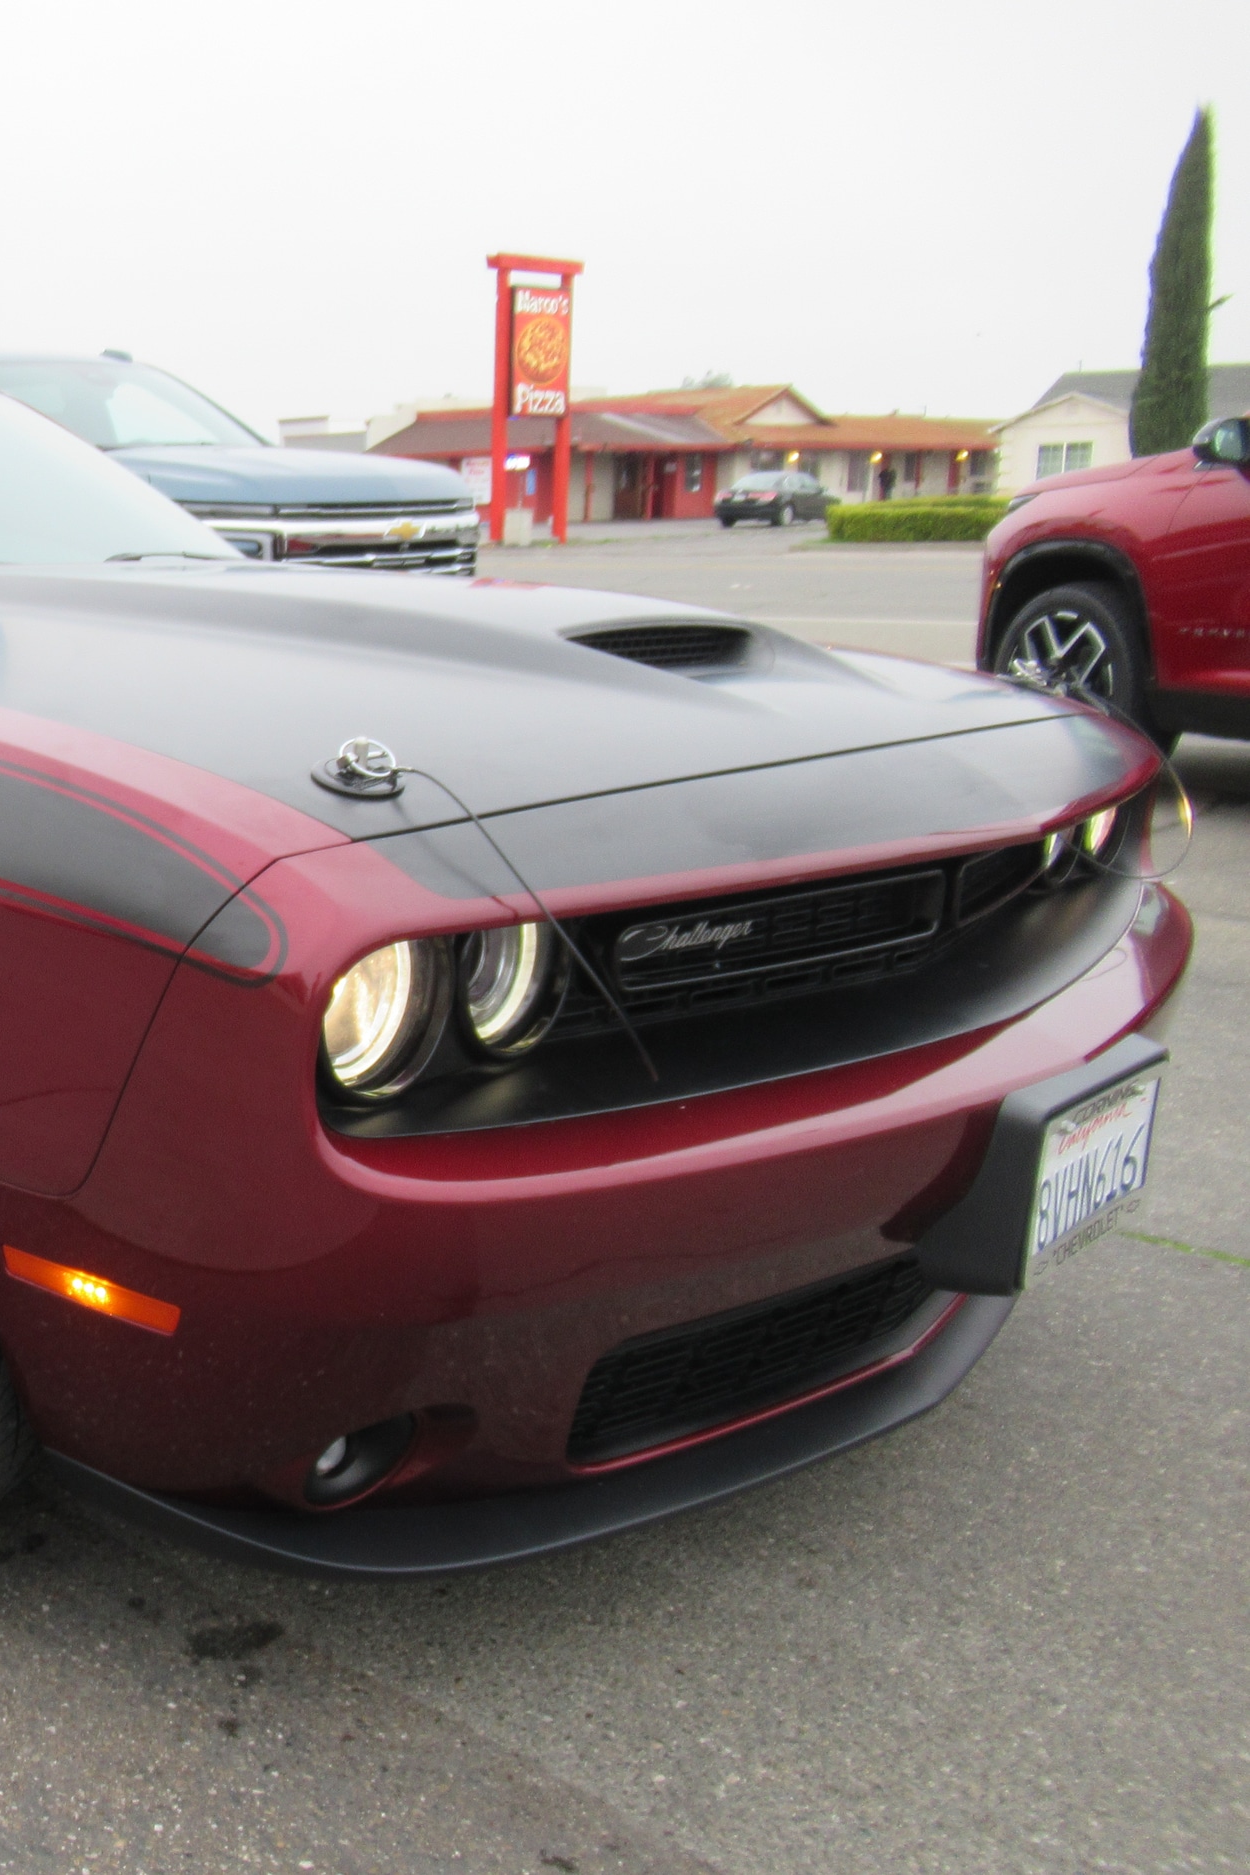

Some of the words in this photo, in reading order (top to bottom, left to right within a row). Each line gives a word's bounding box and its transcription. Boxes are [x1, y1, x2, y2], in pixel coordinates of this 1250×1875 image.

[515, 289, 569, 315] Marco's
[514, 383, 565, 414] Pizza
[620, 919, 753, 961] Challenger
[1037, 1122, 1147, 1252] 8VHN616
